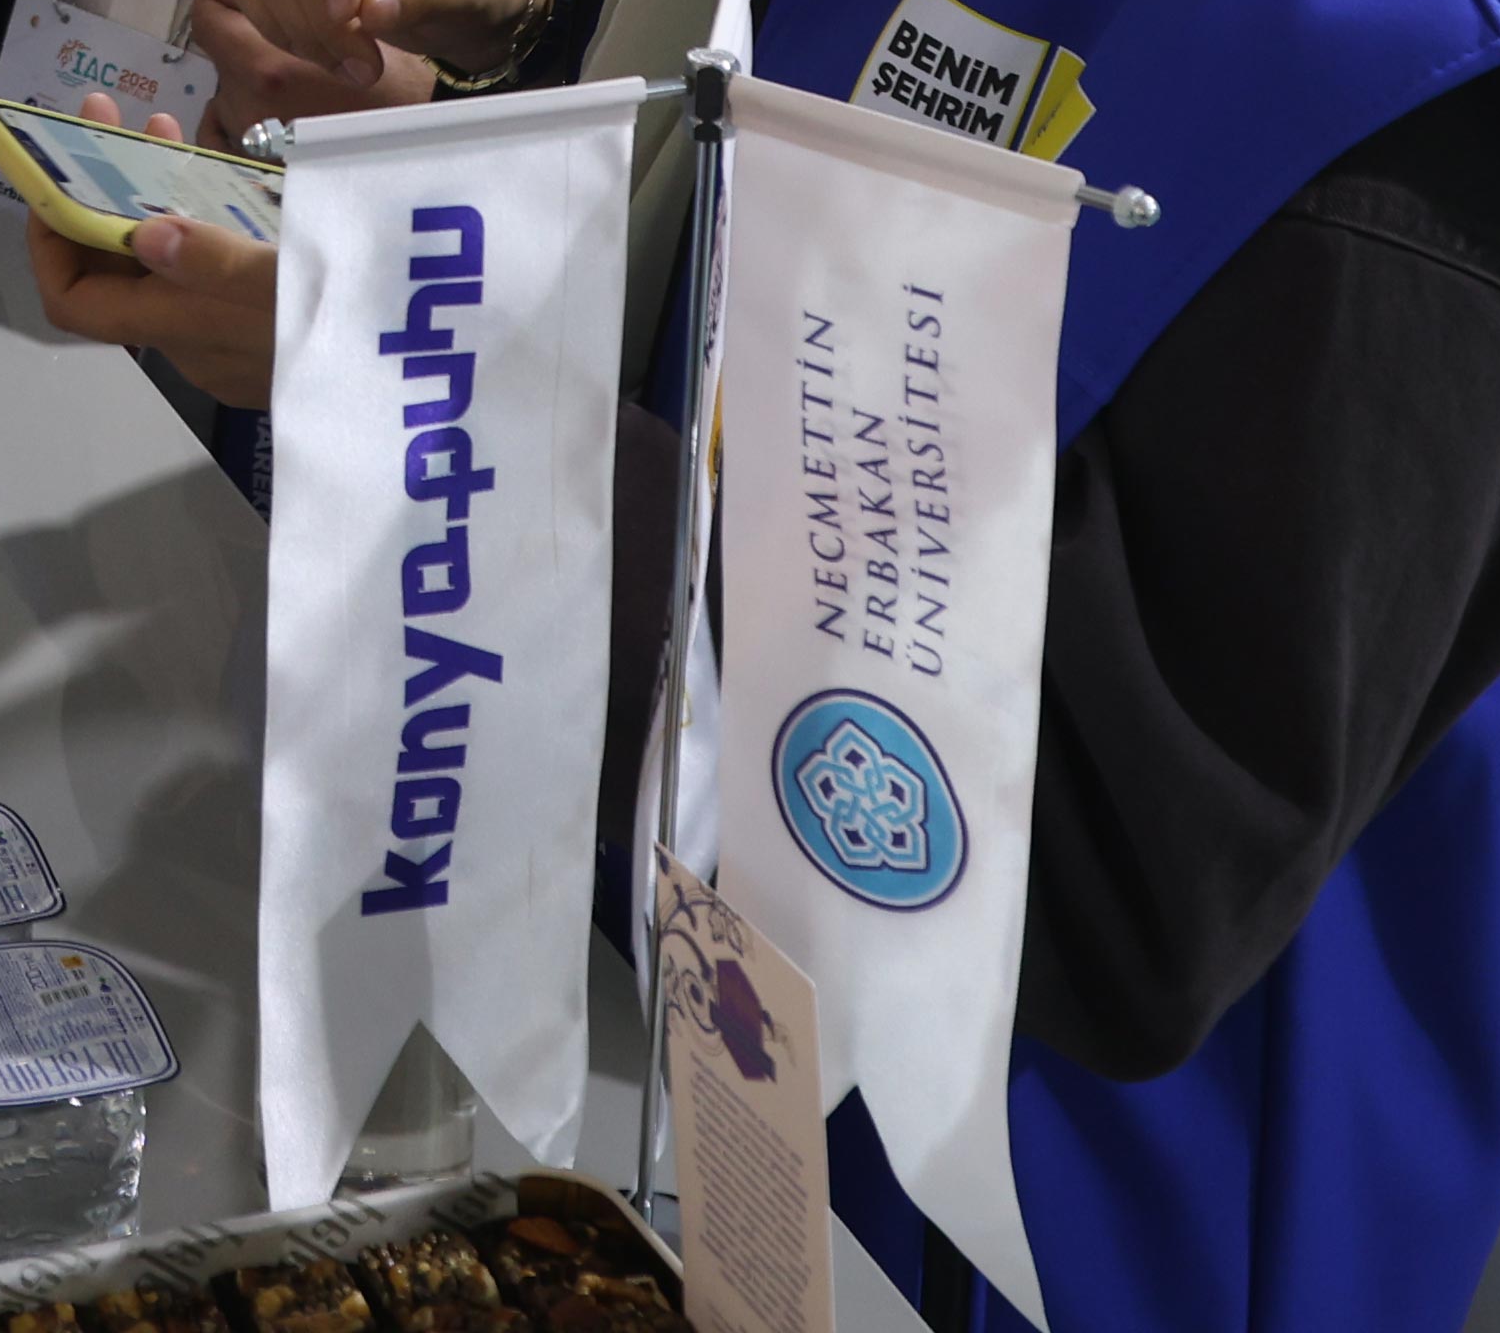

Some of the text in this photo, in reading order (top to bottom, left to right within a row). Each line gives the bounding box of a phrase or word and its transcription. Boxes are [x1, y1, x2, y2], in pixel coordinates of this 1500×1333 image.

[72, 50, 160, 95] IAC 2026
[796, 309, 850, 642] NECMETTİN
[851, 406, 900, 660] ERBAKAN
[898, 282, 951, 679] ÜNİVERSİTESİ
